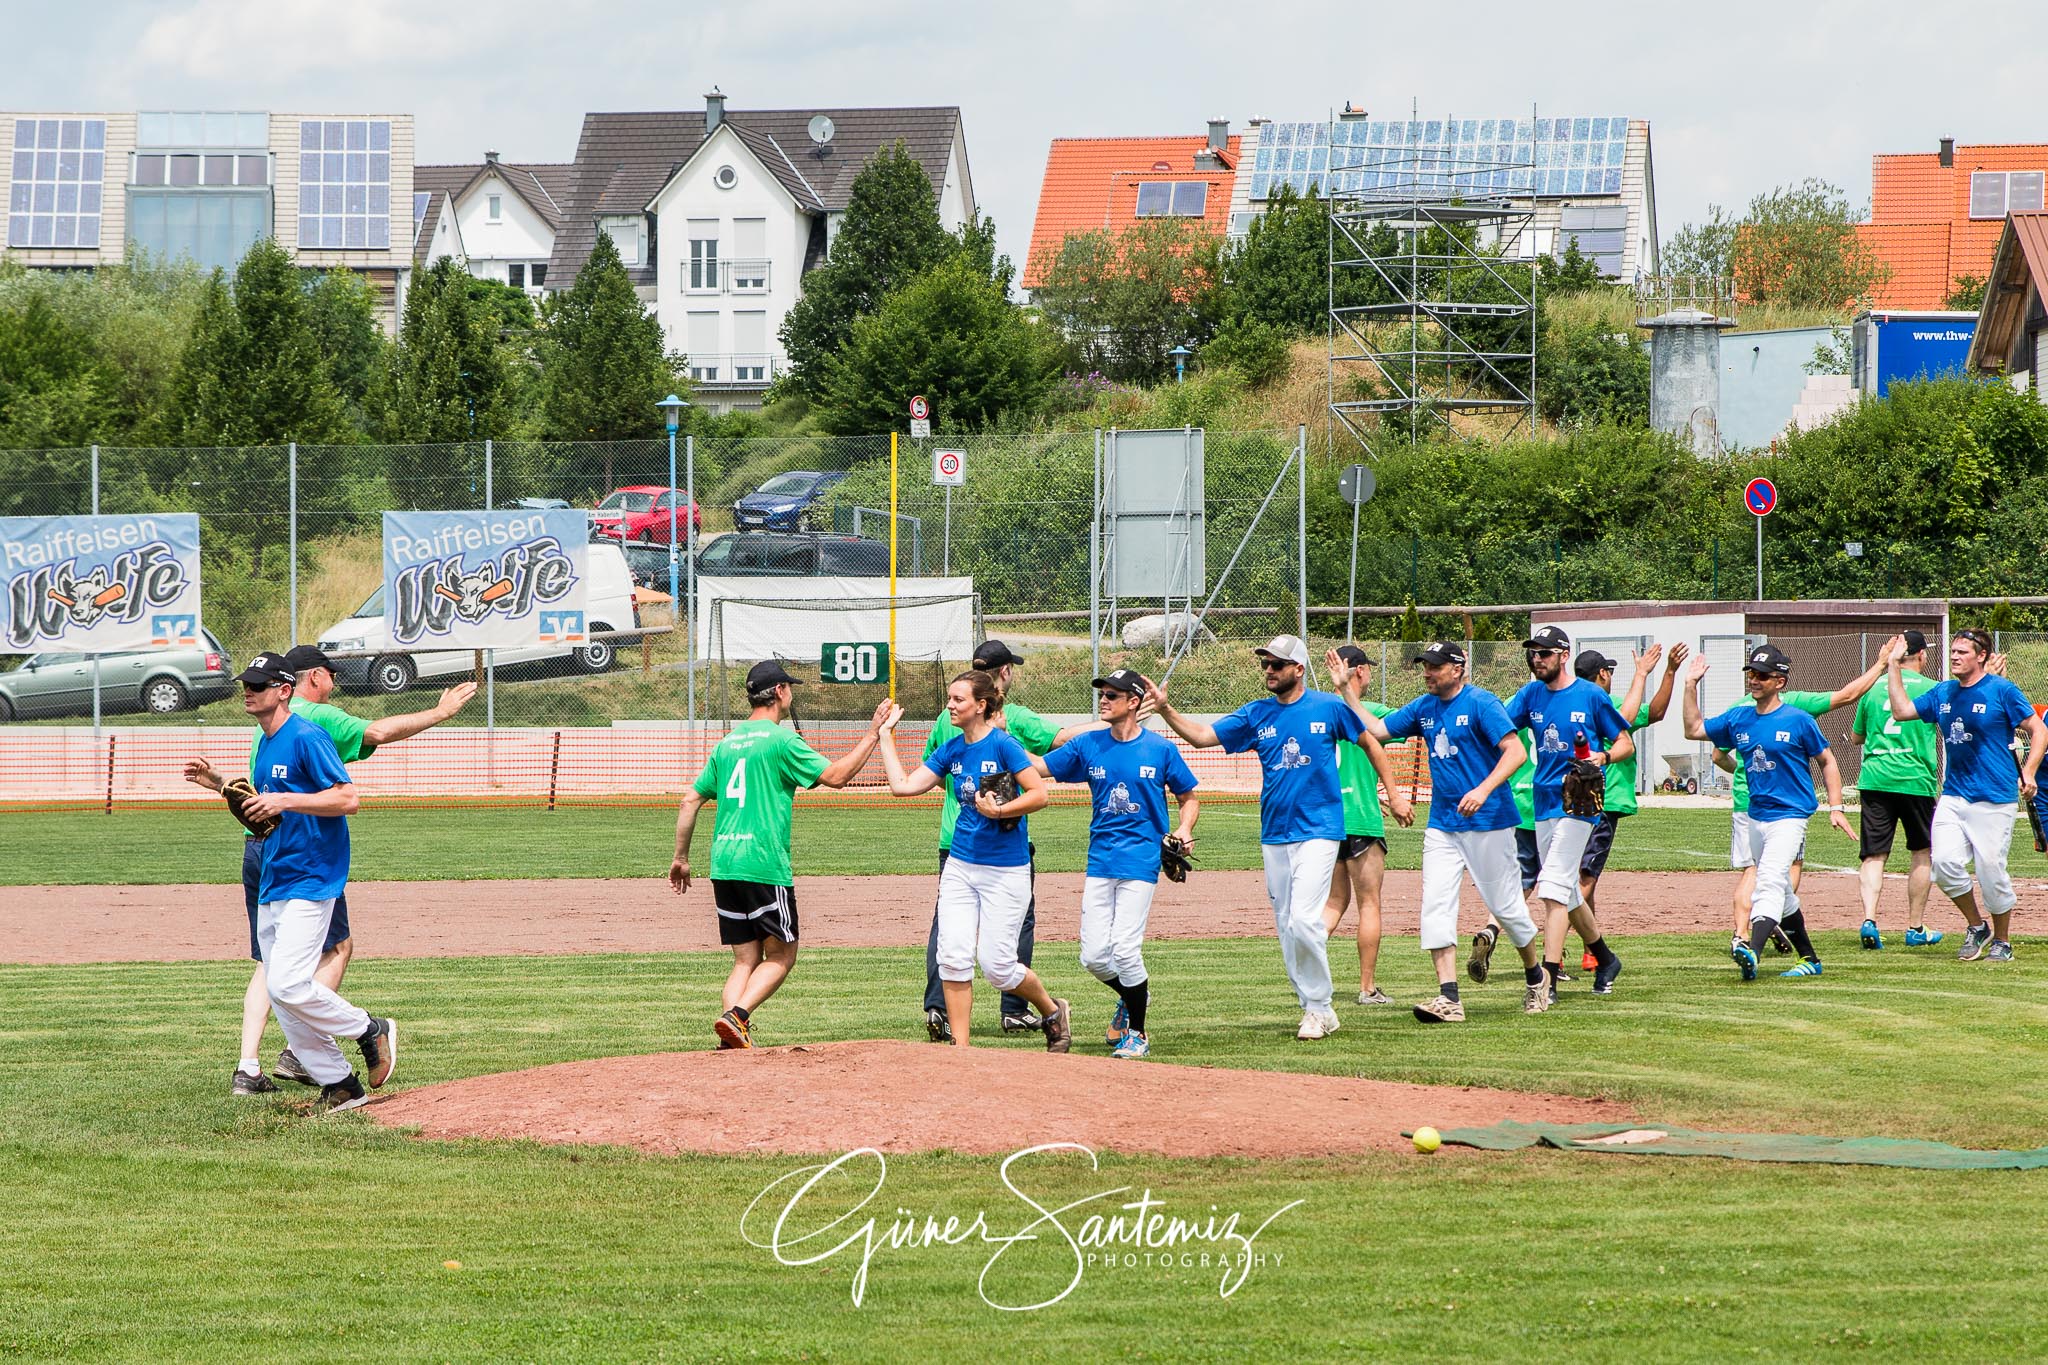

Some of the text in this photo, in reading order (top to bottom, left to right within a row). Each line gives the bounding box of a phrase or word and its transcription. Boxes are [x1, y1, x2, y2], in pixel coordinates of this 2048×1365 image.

[1913, 330, 1975, 341] www.thw-
[944, 459, 956, 470] 30
[3, 519, 158, 570] Raiffeisen
[390, 514, 547, 564] Raiffeisen
[834, 645, 877, 681] 80
[725, 757, 746, 808] 4
